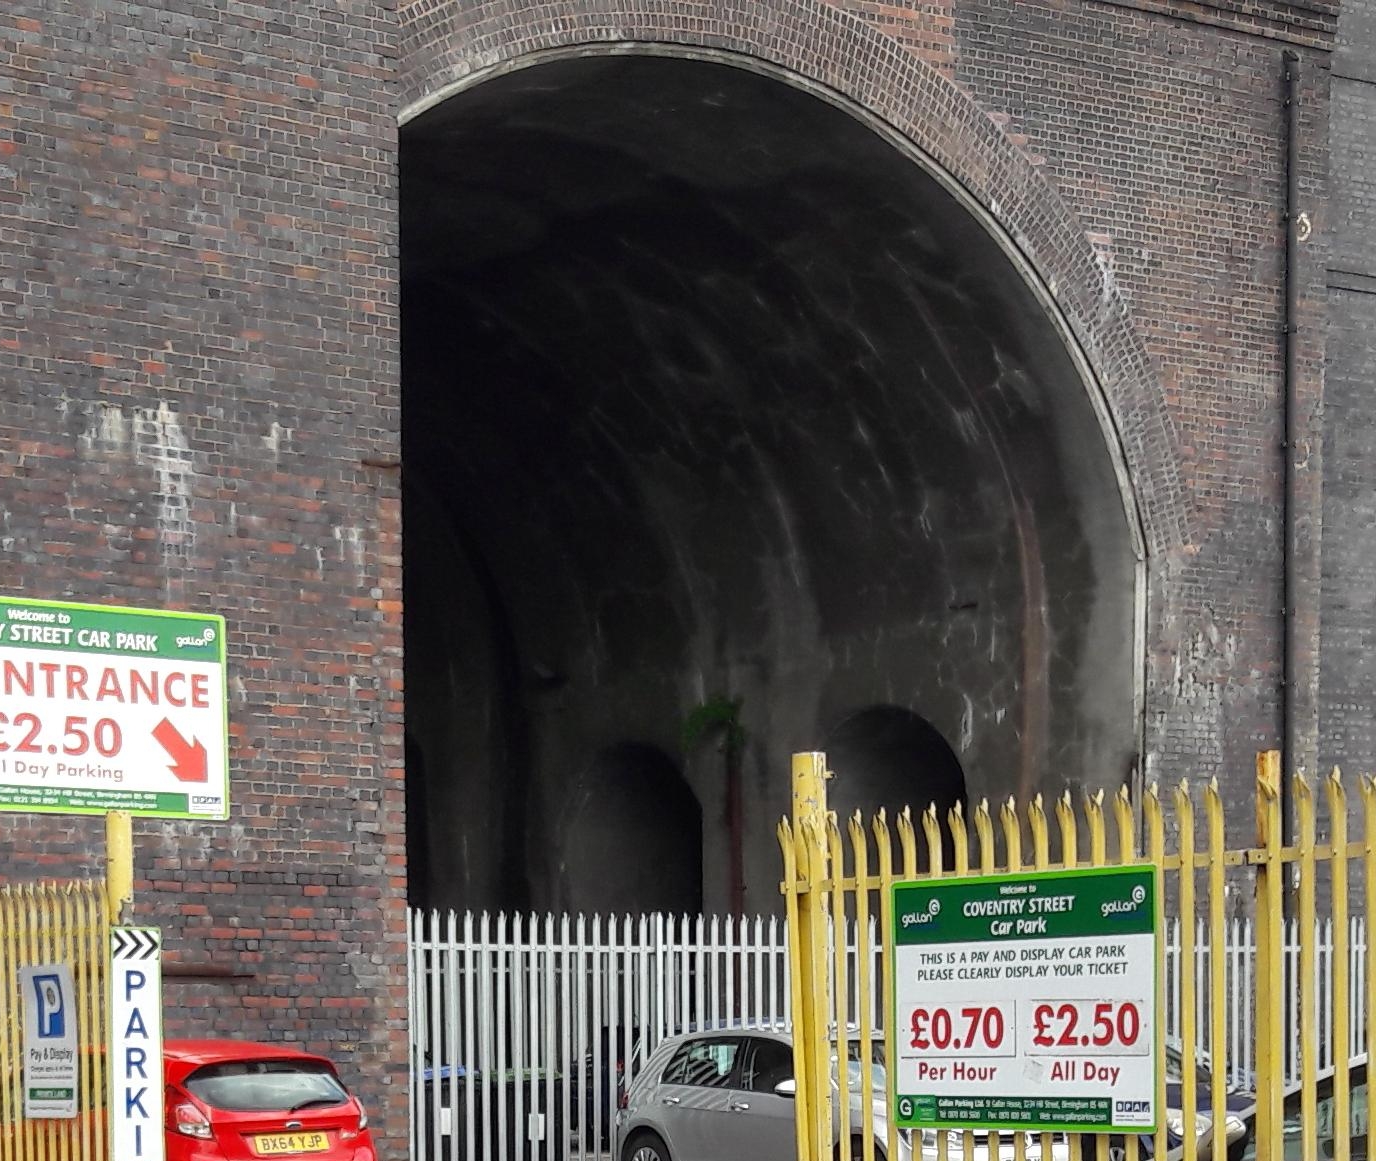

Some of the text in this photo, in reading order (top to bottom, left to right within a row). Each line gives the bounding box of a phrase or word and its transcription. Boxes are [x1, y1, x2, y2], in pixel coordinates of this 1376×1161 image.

[7, 608, 71, 624] Welcome to
[9, 623, 74, 645] STREET
[77, 629, 111, 648] CAR
[116, 632, 159, 652] PARK
[14, 761, 50, 780] Day
[56, 763, 125, 783] Parking
[963, 895, 1076, 917] COVENTRY STREET
[990, 916, 1047, 936] Car Park
[919, 944, 1126, 966] THIS IS A PAY AND DISPLAY CAR PARK
[917, 961, 1129, 982] PLEASE CLEARLY DISPLAY YOUR TICKET
[910, 1006, 1004, 1050] £0.70
[1032, 1002, 1140, 1047] £2.50
[30, 1047, 42, 1063] Pay
[49, 1047, 74, 1063] Display
[918, 1061, 998, 1081] Per Hour
[1050, 1060, 1121, 1086] All Day
[899, 1098, 912, 1116] G
[260, 1134, 322, 1151] BX64 YJP
